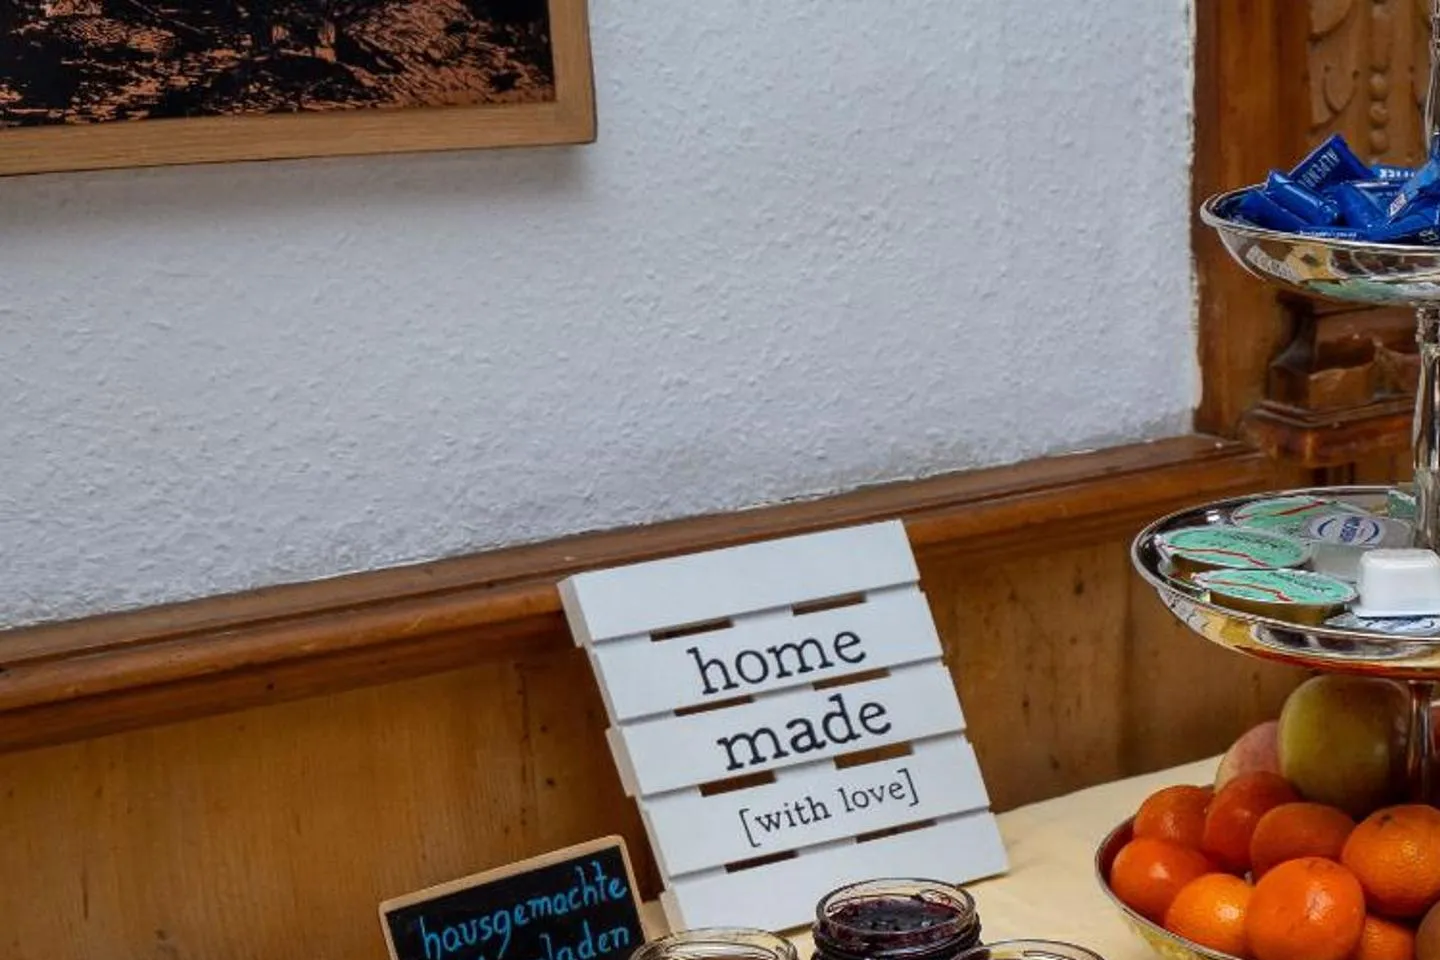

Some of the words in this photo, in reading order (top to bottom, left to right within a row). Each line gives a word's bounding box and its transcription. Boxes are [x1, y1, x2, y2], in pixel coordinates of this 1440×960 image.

[687, 629, 867, 695] home
[717, 693, 892, 771] made
[738, 794, 832, 848] [with
[837, 768, 920, 814] love]
[419, 860, 628, 960] hausgemachte
